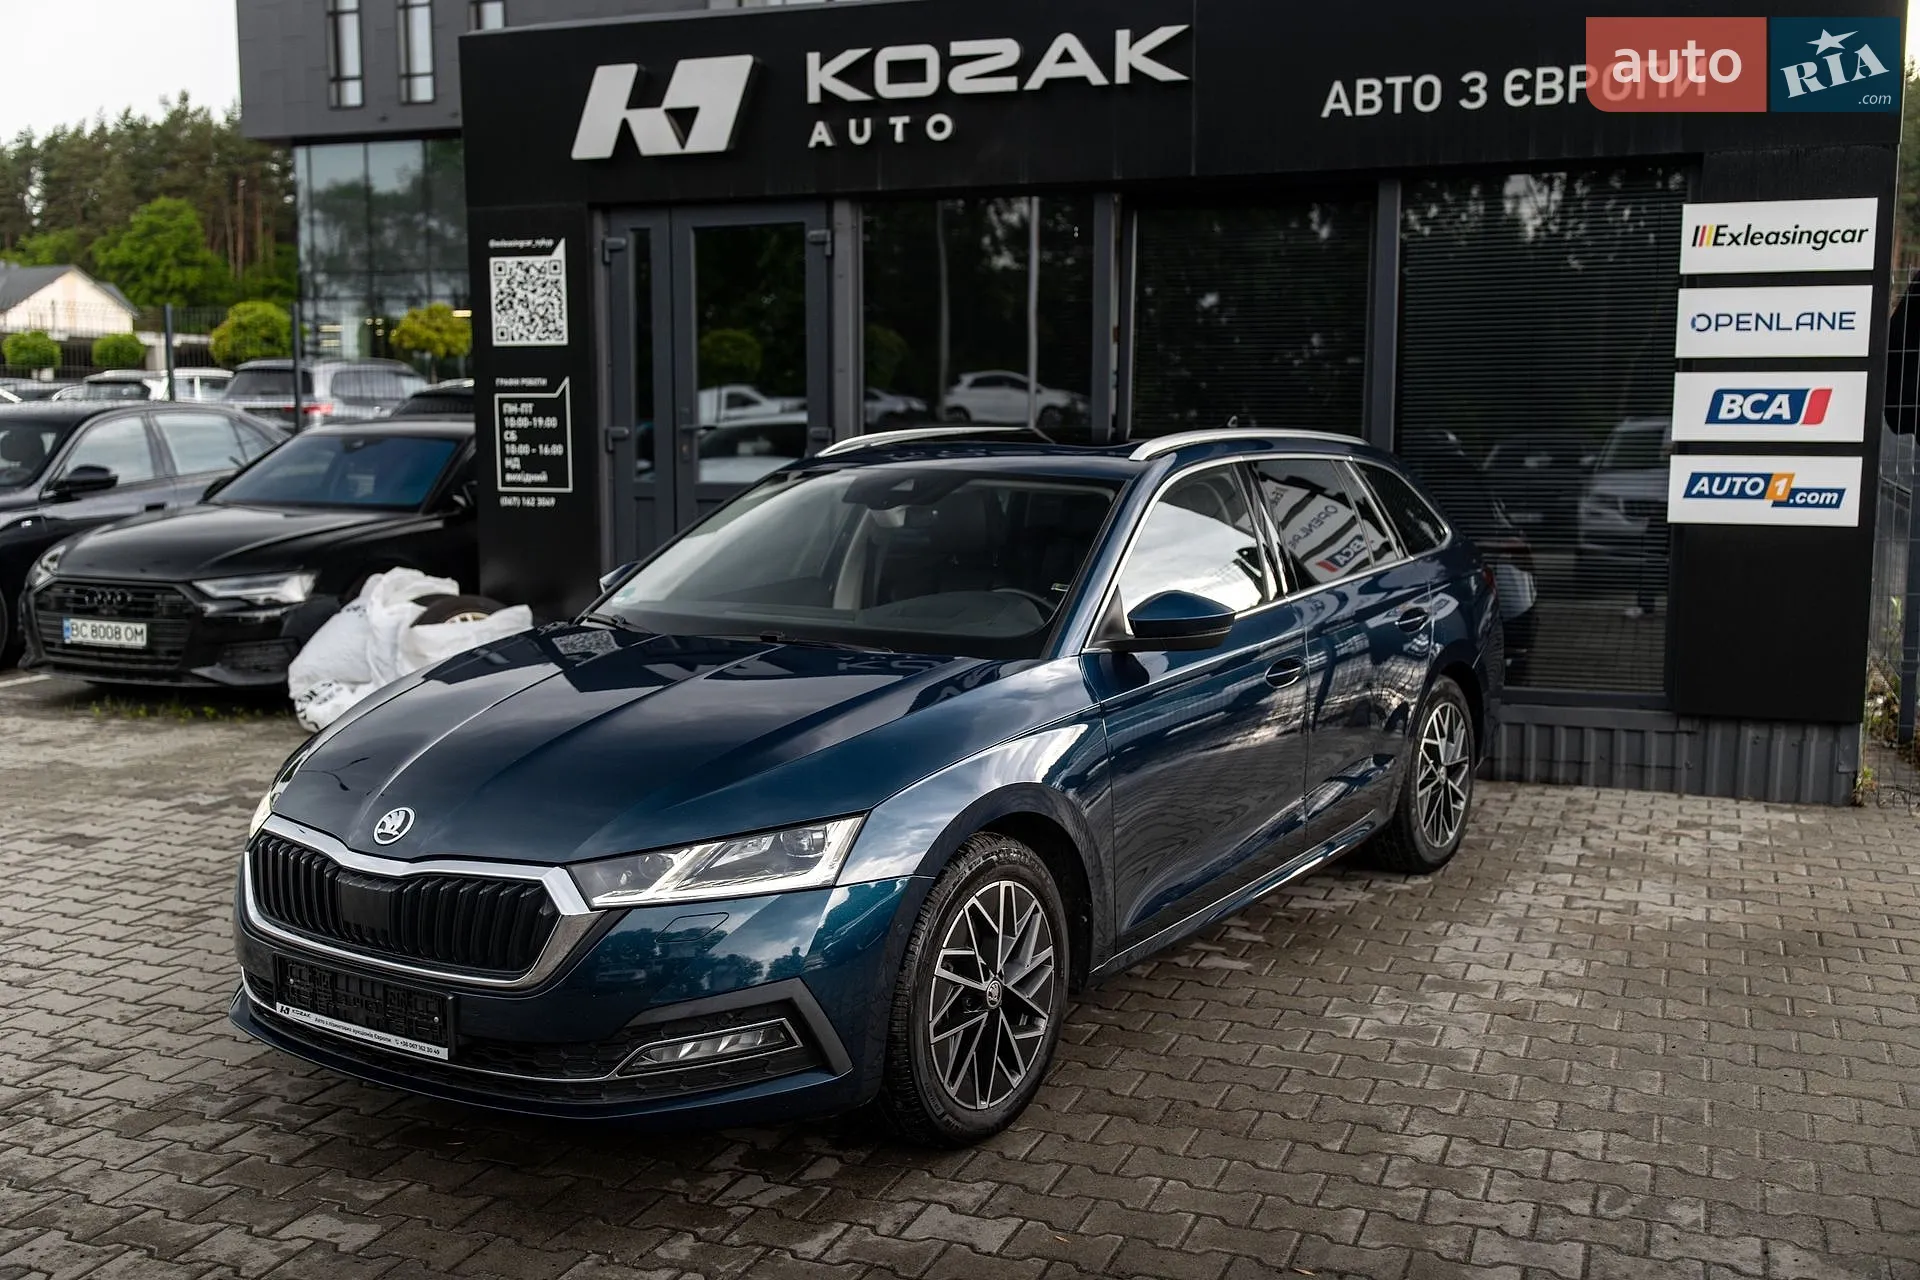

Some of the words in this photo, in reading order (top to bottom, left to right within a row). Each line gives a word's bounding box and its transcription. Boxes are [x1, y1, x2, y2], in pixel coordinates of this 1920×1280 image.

[806, 24, 1190, 104] KOZAK
[1320, 73, 1442, 118] АВТО
[1458, 70, 1488, 110] З
[808, 113, 953, 148] AUTO
[1712, 224, 1869, 251] Exleasingcar
[1690, 312, 1856, 332] OPENLANE
[1718, 393, 1791, 420] BCA
[504, 430, 518, 442] СБ
[505, 457, 521, 470] НД
[71, 622, 88, 639] BC
[91, 624, 122, 641] 8008
[124, 626, 144, 642] OM
